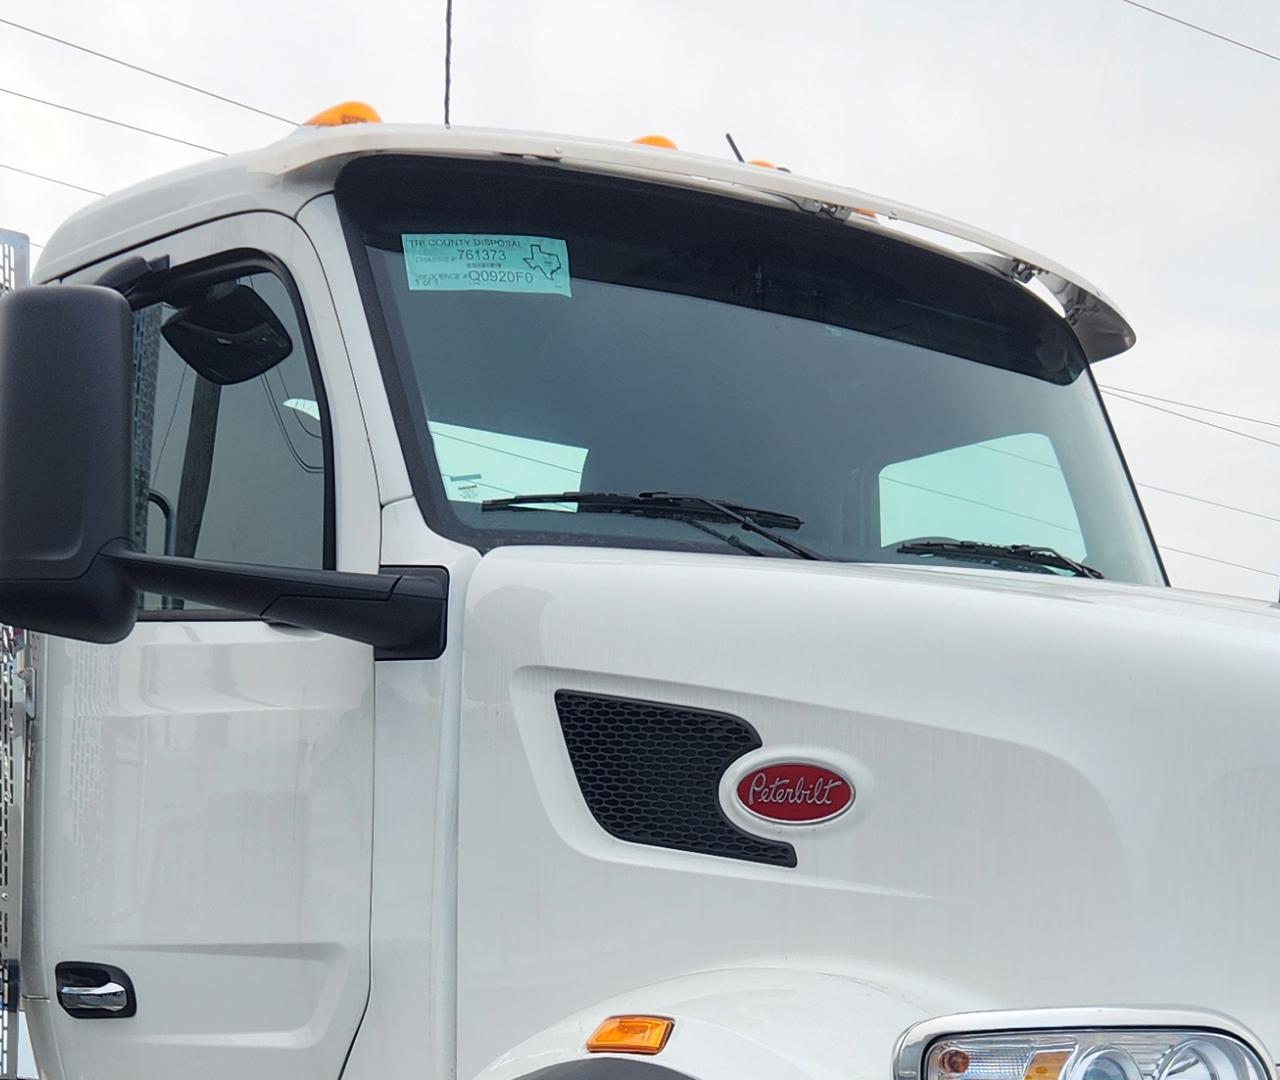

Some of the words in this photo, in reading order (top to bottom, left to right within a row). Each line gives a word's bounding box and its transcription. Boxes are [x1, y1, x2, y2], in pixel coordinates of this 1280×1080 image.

[409, 239, 426, 248] TRI
[428, 239, 470, 247] COUNTY
[473, 239, 522, 248] DISPOSAL
[457, 249, 507, 261] 761373
[468, 270, 534, 284] Q0920F0
[748, 772, 843, 806] Peterbilt
